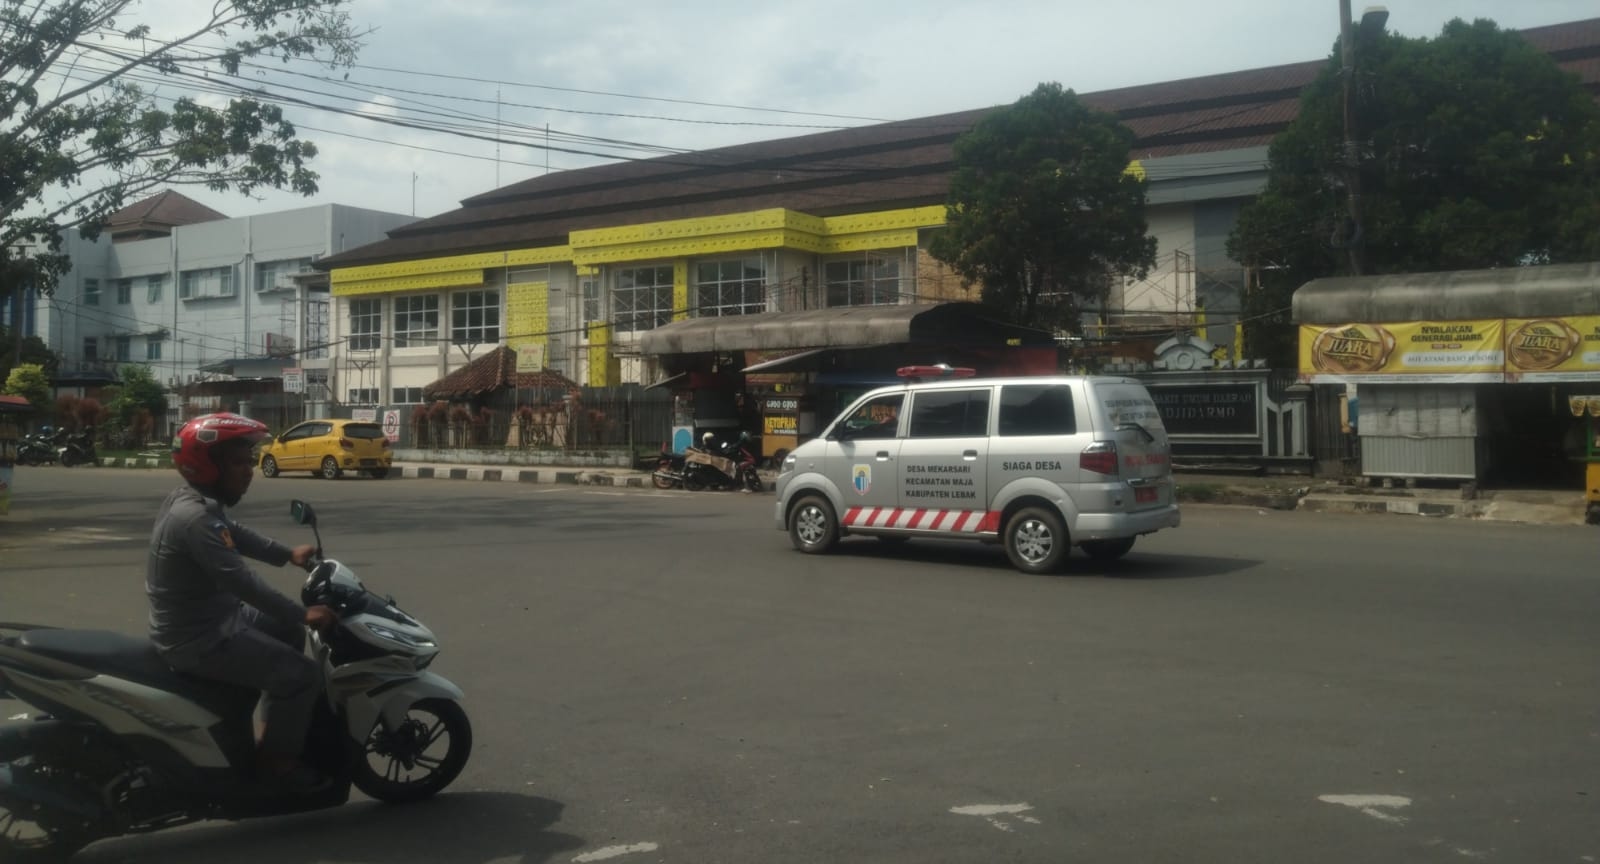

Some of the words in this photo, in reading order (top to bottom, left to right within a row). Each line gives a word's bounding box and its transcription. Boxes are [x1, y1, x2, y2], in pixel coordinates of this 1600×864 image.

[1421, 325, 1473, 334] NYALAKAN
[1411, 334, 1449, 342] GENERASI
[1454, 333, 1484, 341] JUARA
[1327, 338, 1373, 356] JUARA
[1519, 335, 1561, 350] JUARA
[907, 465, 926, 473] DESA
[927, 465, 971, 473] MEKARSARI
[1002, 461, 1032, 471] SIAGA
[1035, 461, 1062, 470] DESA
[905, 478, 951, 486] KECAMATAN
[952, 478, 974, 486] MAJA
[905, 490, 949, 498] KABUPATEN
[951, 490, 976, 499] LEBAK
